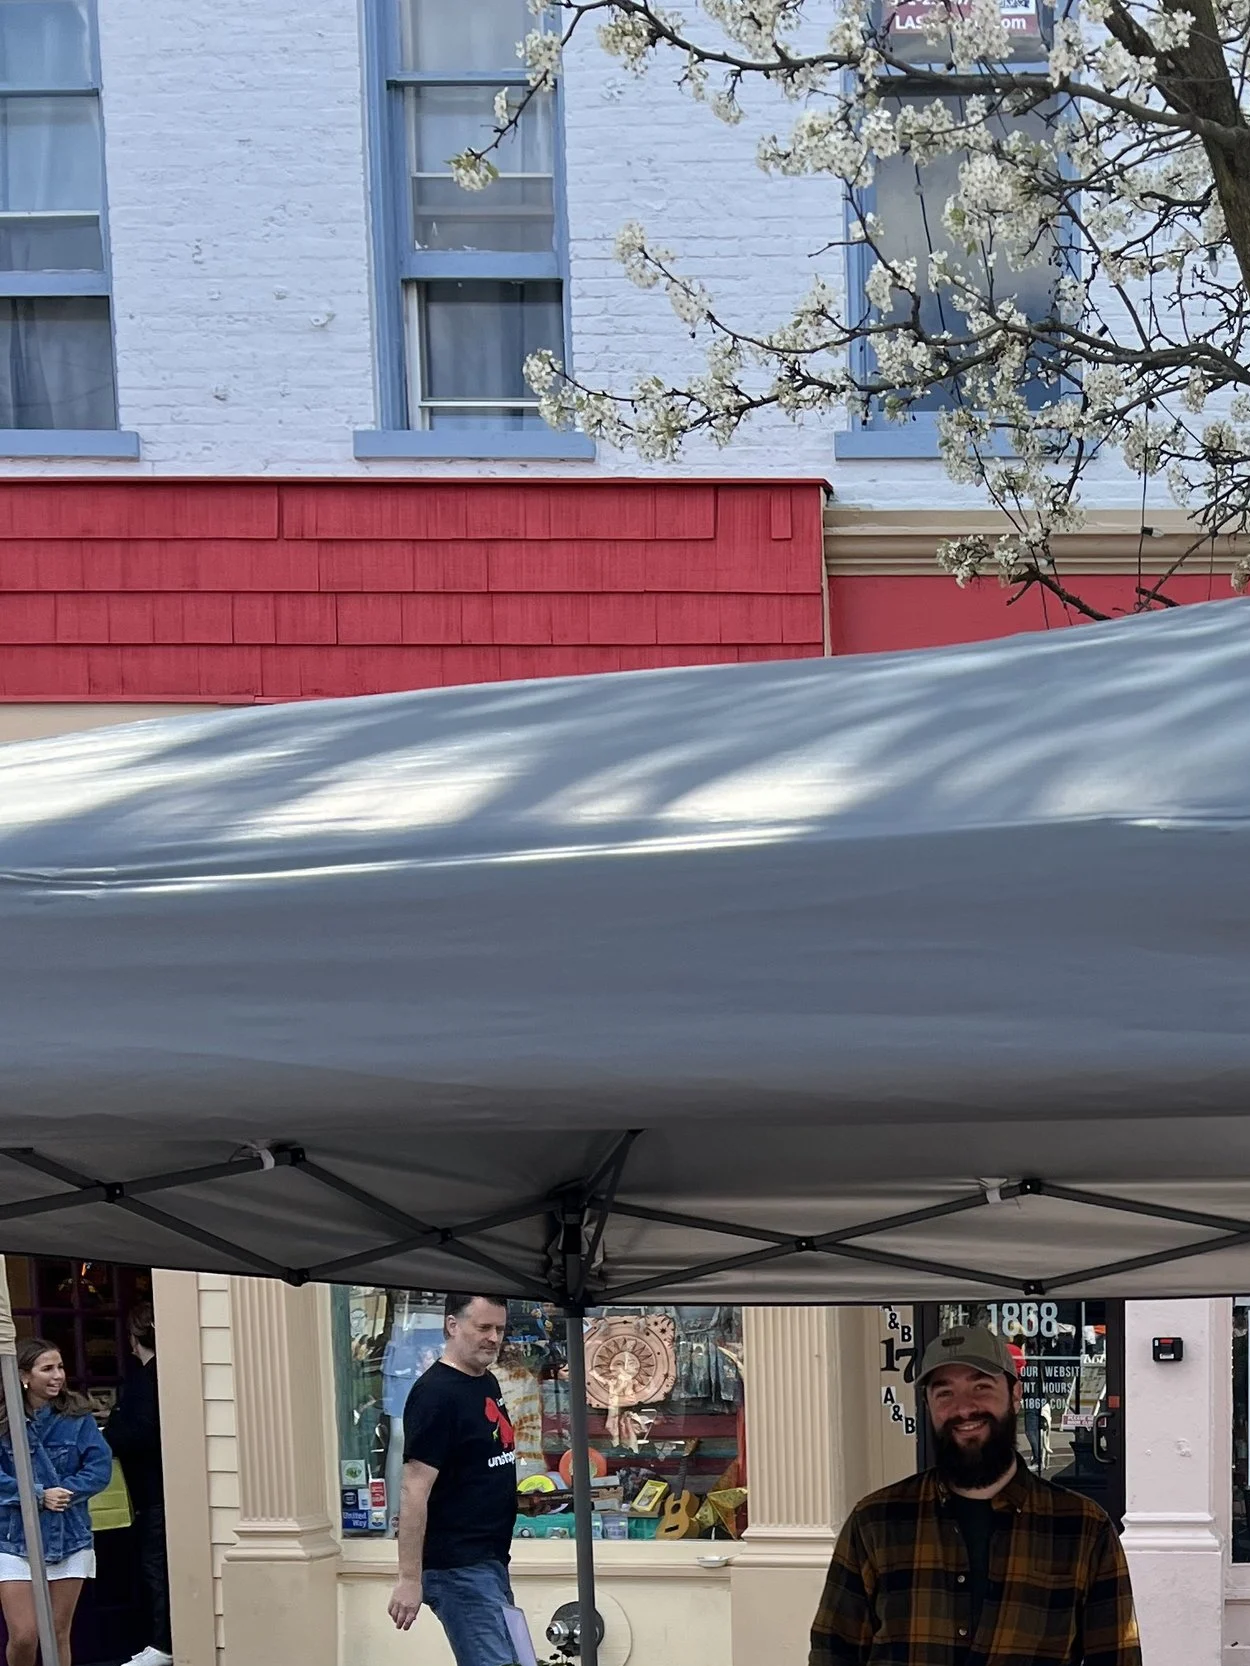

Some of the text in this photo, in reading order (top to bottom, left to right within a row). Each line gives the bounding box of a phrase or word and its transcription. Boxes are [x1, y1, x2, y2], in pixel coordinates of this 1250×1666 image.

[889, 1312, 912, 1342] & B
[987, 1303, 1058, 1337] 1868
[880, 1338, 917, 1383] 17
[1045, 1366, 1086, 1377] WEBSITE
[1042, 1382, 1073, 1394] HOURS
[884, 1387, 915, 1434] A & B
[352, 1520, 367, 1528] Way
